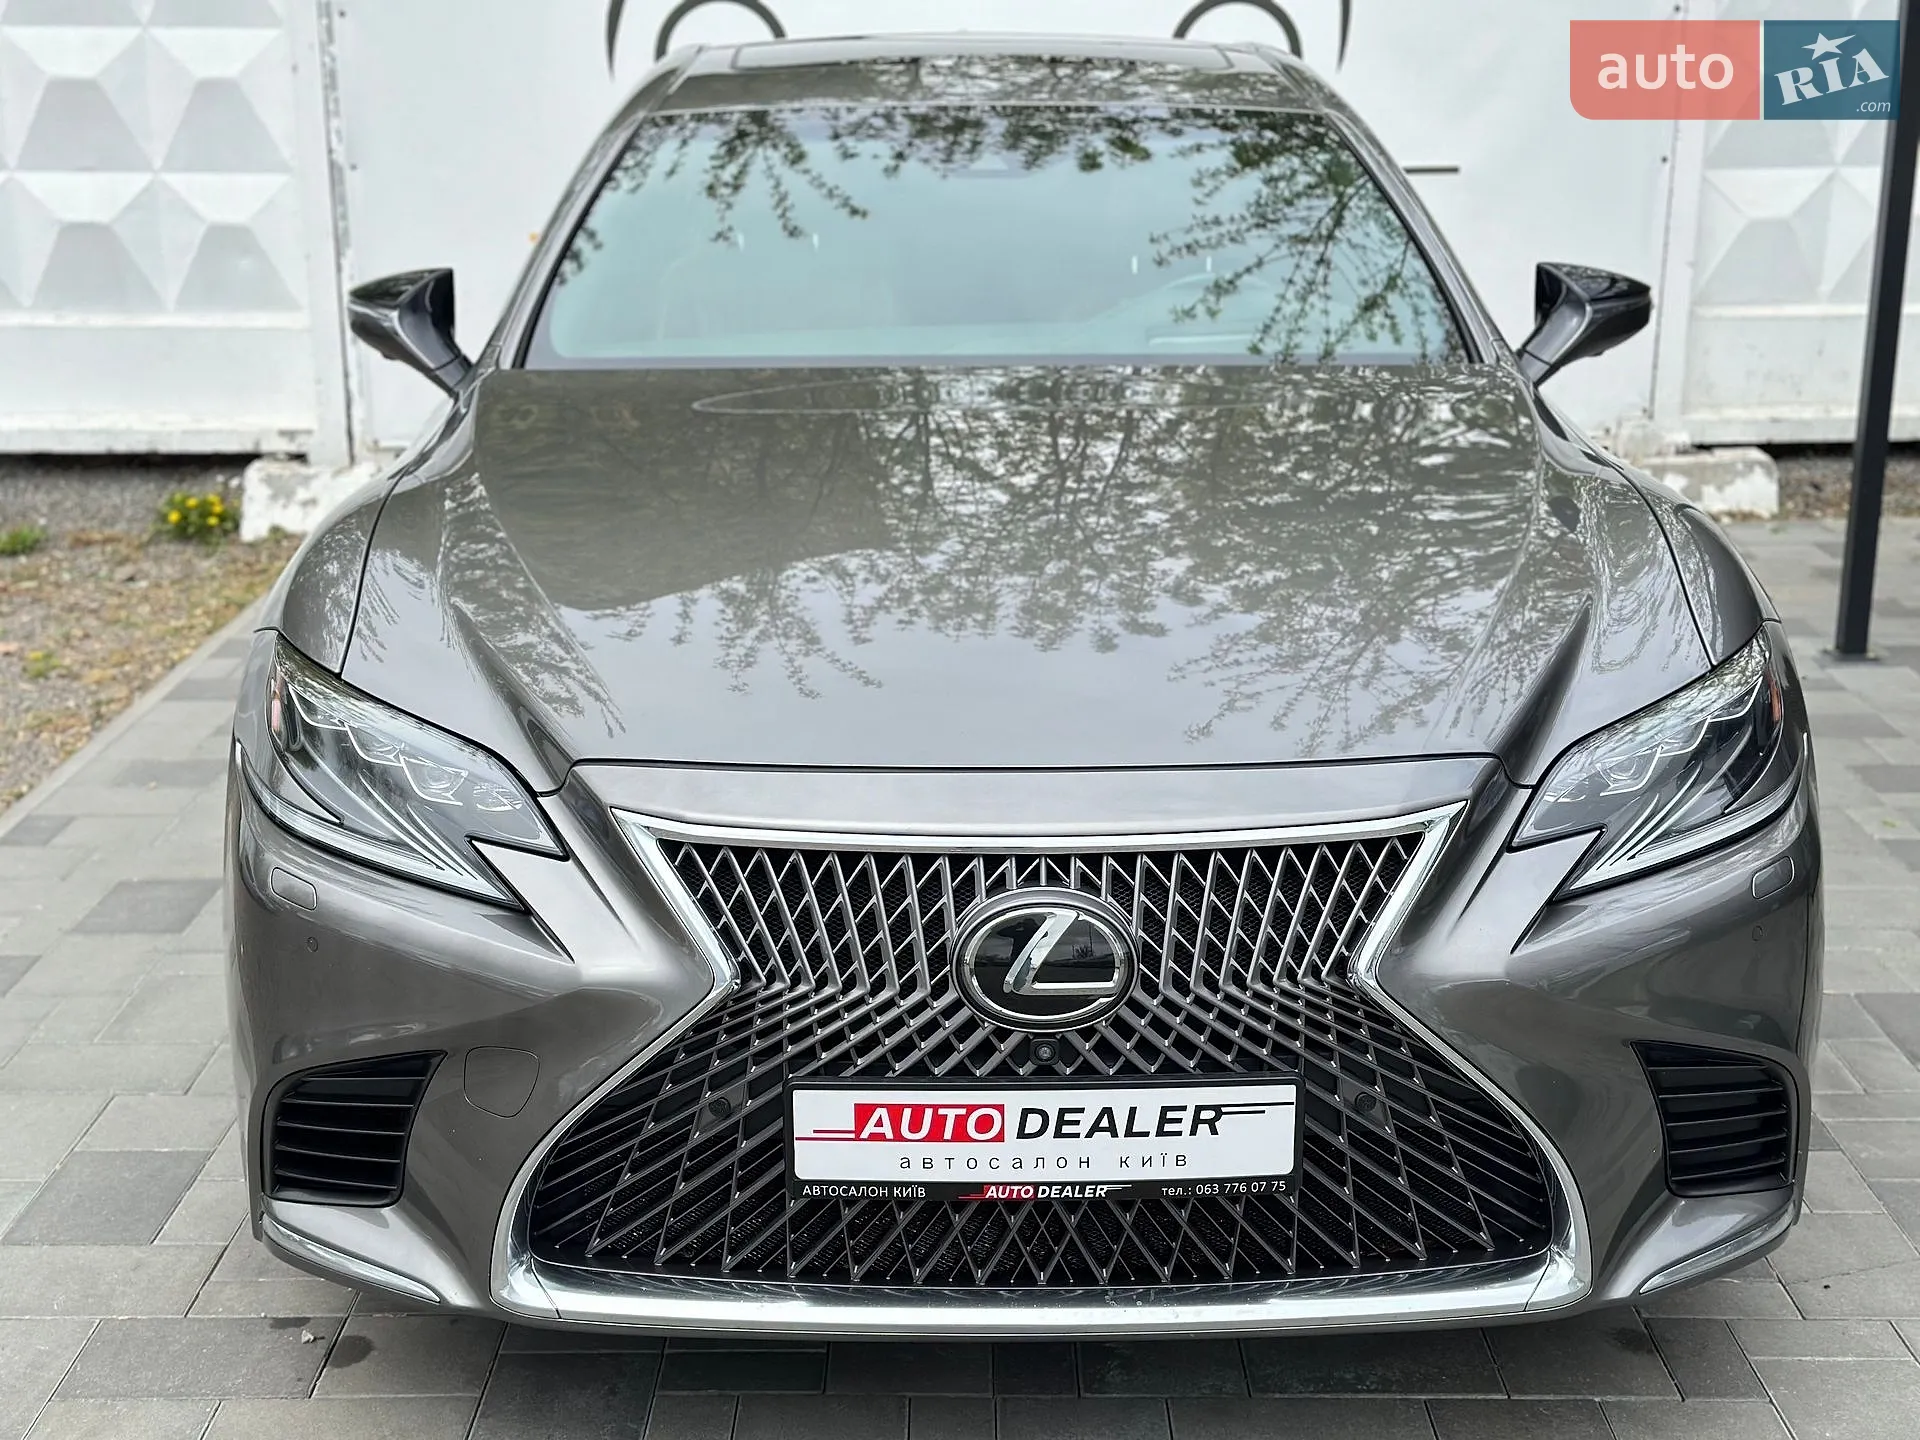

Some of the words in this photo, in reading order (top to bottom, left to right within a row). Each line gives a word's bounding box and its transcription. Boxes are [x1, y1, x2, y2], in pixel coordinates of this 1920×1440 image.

[859, 1107, 1002, 1141] AUTO
[1016, 1105, 1223, 1140] DEALER
[900, 1156, 1090, 1170] автосалон
[1119, 1153, 1187, 1169] київ
[802, 1184, 888, 1198] АВТОСАЛОН
[893, 1184, 926, 1198] КИЇВ
[985, 1185, 1034, 1199] AUTO
[1037, 1185, 1108, 1199] DEALER
[1161, 1186, 1192, 1197] тел.:
[1196, 1183, 1219, 1195] 063
[1224, 1182, 1247, 1194] 776
[1251, 1181, 1267, 1193] 07
[1271, 1180, 1286, 1192] 75
